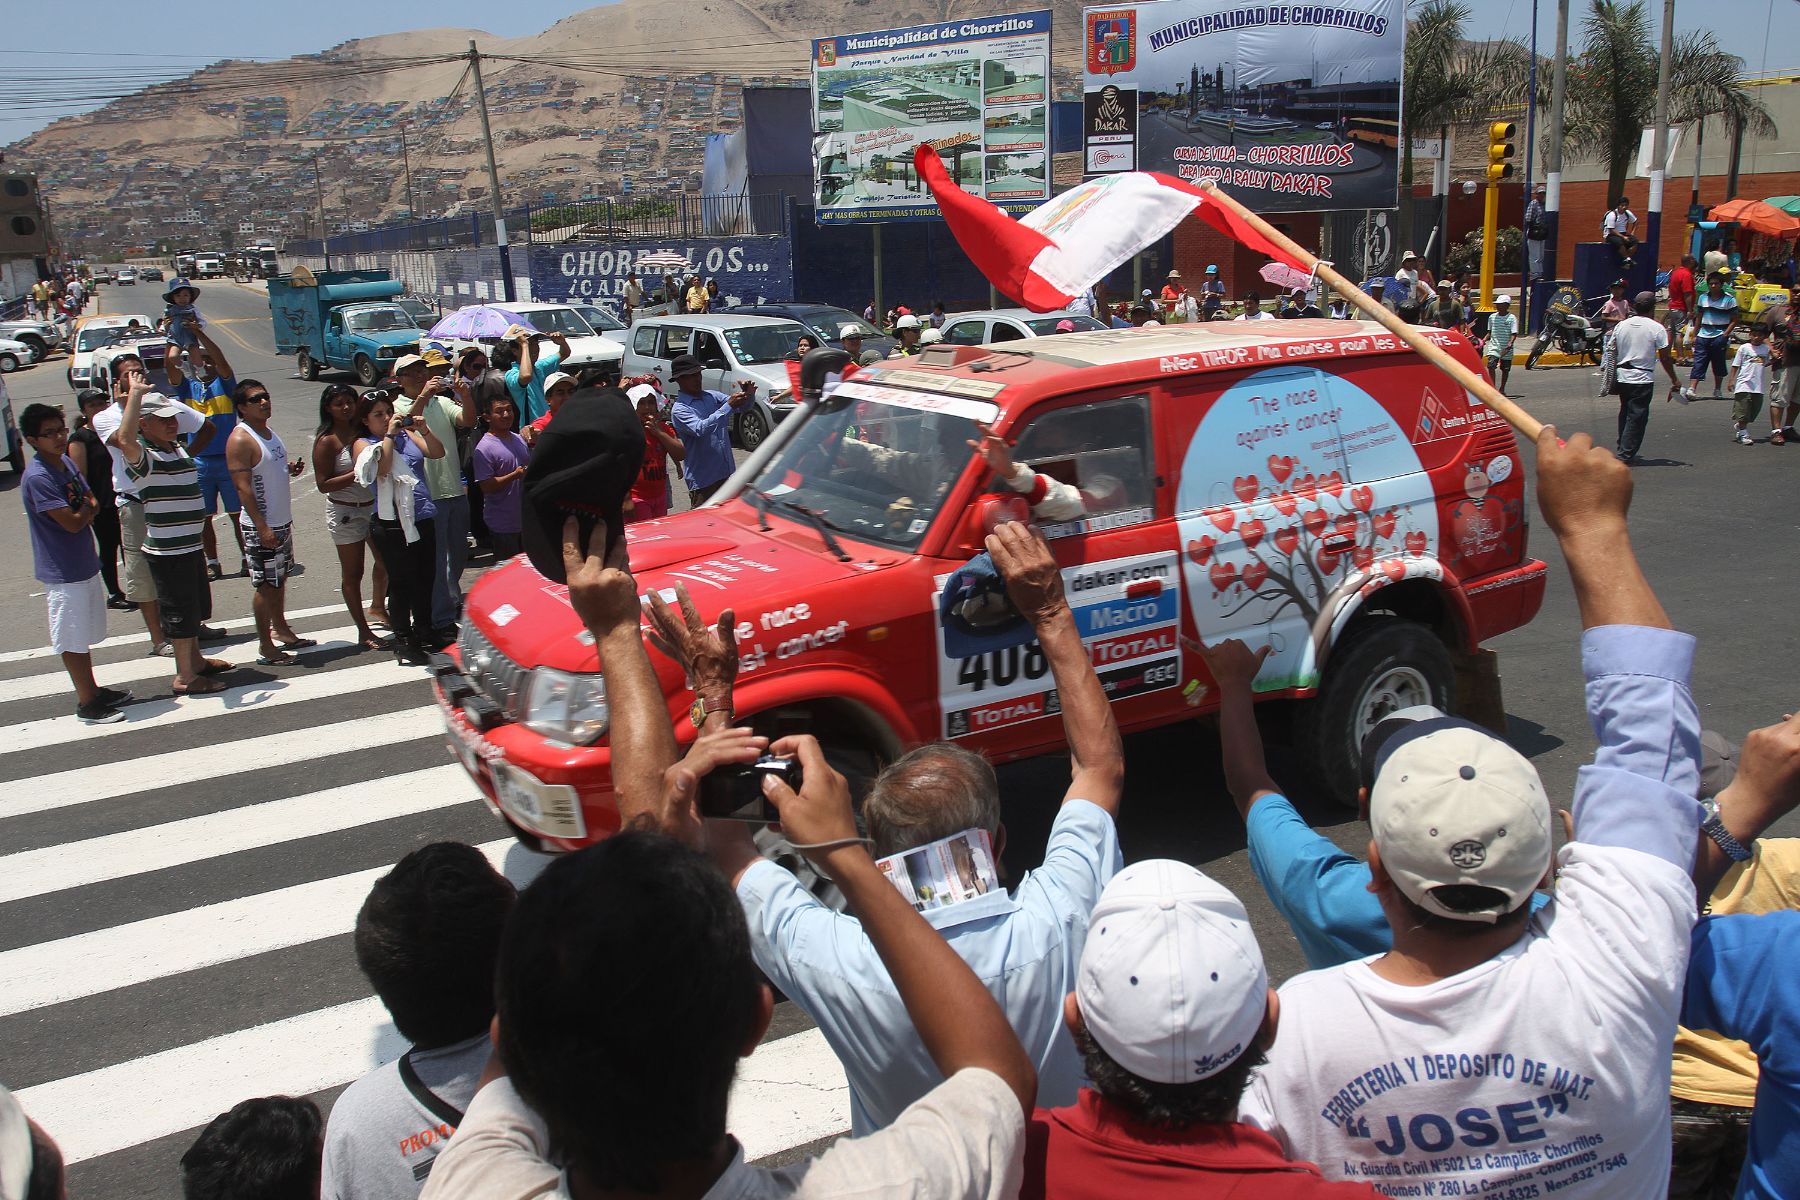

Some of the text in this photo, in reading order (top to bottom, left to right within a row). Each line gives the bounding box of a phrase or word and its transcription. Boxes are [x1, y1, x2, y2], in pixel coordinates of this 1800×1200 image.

[846, 18, 1034, 51] Municipalidad de Chorrillos
[1149, 5, 1387, 51] MUNICIPALIDAD DE CHORRILLOS
[851, 58, 882, 68] Parque
[884, 52, 925, 65] Navidad
[941, 48, 969, 58] Villa
[1094, 117, 1128, 132] DAKAR
[1174, 146, 1197, 160] CURVA
[1198, 146, 1211, 160] DE
[1211, 146, 1236, 162] VILLA
[1249, 143, 1354, 166] CHORRILLOS
[1222, 167, 1231, 183] A
[1234, 170, 1270, 189] RALLY
[1272, 173, 1332, 199] DAKAR
[822, 212, 834, 220] HAY
[835, 211, 847, 219] MAS
[848, 210, 868, 218] OBRAS
[868, 209, 909, 217] TERMINADAS
[909, 209, 914, 217] Y
[915, 208, 936, 217] OTRAS
[1257, 344, 1282, 361] Ma
[1285, 341, 1335, 358] course
[1339, 339, 1369, 355] pour
[1373, 335, 1395, 350] les
[1247, 389, 1319, 416] The race
[1236, 416, 1290, 450] against
[1296, 407, 1343, 432] cancer
[1072, 562, 1168, 592] dakar.com
[760, 602, 812, 631] race
[1091, 602, 1158, 630] Macro
[775, 620, 850, 661] cancer
[1096, 634, 1173, 661] TOTAL
[957, 636, 1050, 692] 408
[971, 702, 1042, 726] TOTAL
[1195, 1043, 1242, 1075] adidas
[1321, 1053, 1595, 1129] FERRETERIA Y DEPOSITO DE MAT.
[1344, 1161, 1359, 1177] Av.
[1360, 1160, 1401, 1177] Guardia
[1404, 1158, 1429, 1175] Civil
[1467, 1155, 1482, 1170] La
[1546, 1134, 1604, 1160] Chorrillos
[1439, 1181, 1460, 1197] 280
[1462, 1179, 1478, 1195] La
